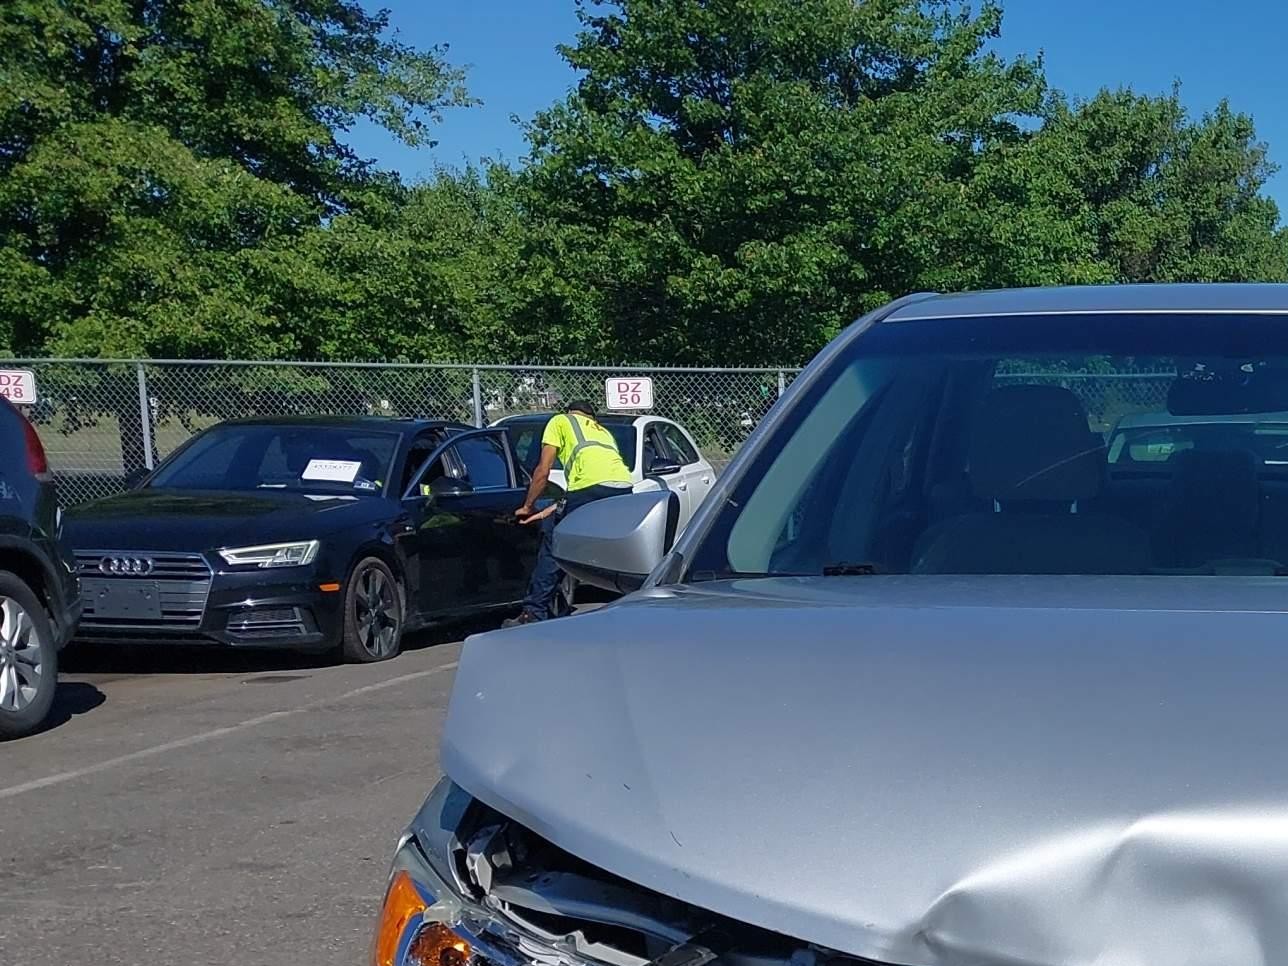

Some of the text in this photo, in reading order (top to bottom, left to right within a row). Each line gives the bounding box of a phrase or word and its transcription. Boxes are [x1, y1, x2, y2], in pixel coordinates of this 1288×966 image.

[0, 374, 24, 386] DZ
[617, 382, 642, 393] DZ
[619, 393, 641, 404] 50
